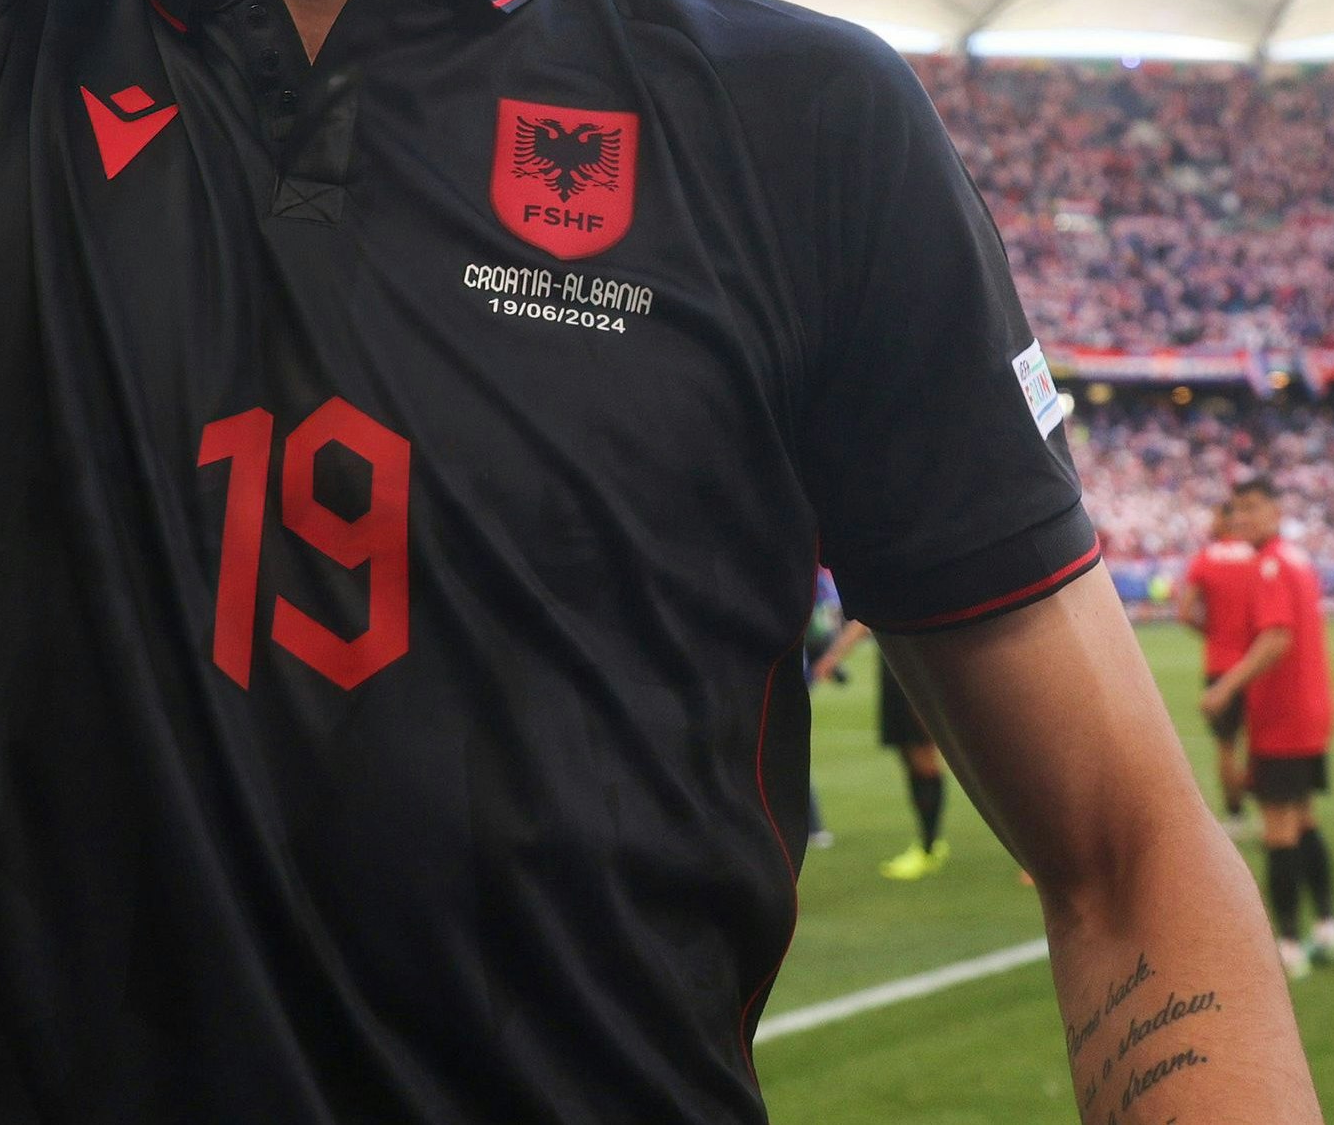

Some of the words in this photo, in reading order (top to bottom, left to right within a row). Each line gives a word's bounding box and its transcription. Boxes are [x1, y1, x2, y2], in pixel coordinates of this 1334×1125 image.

[523, 204, 604, 233] FSHF
[463, 263, 654, 315] CROATIA-ALBANIA
[488, 298, 626, 334] 19/06/2024
[196, 395, 411, 691] 19
